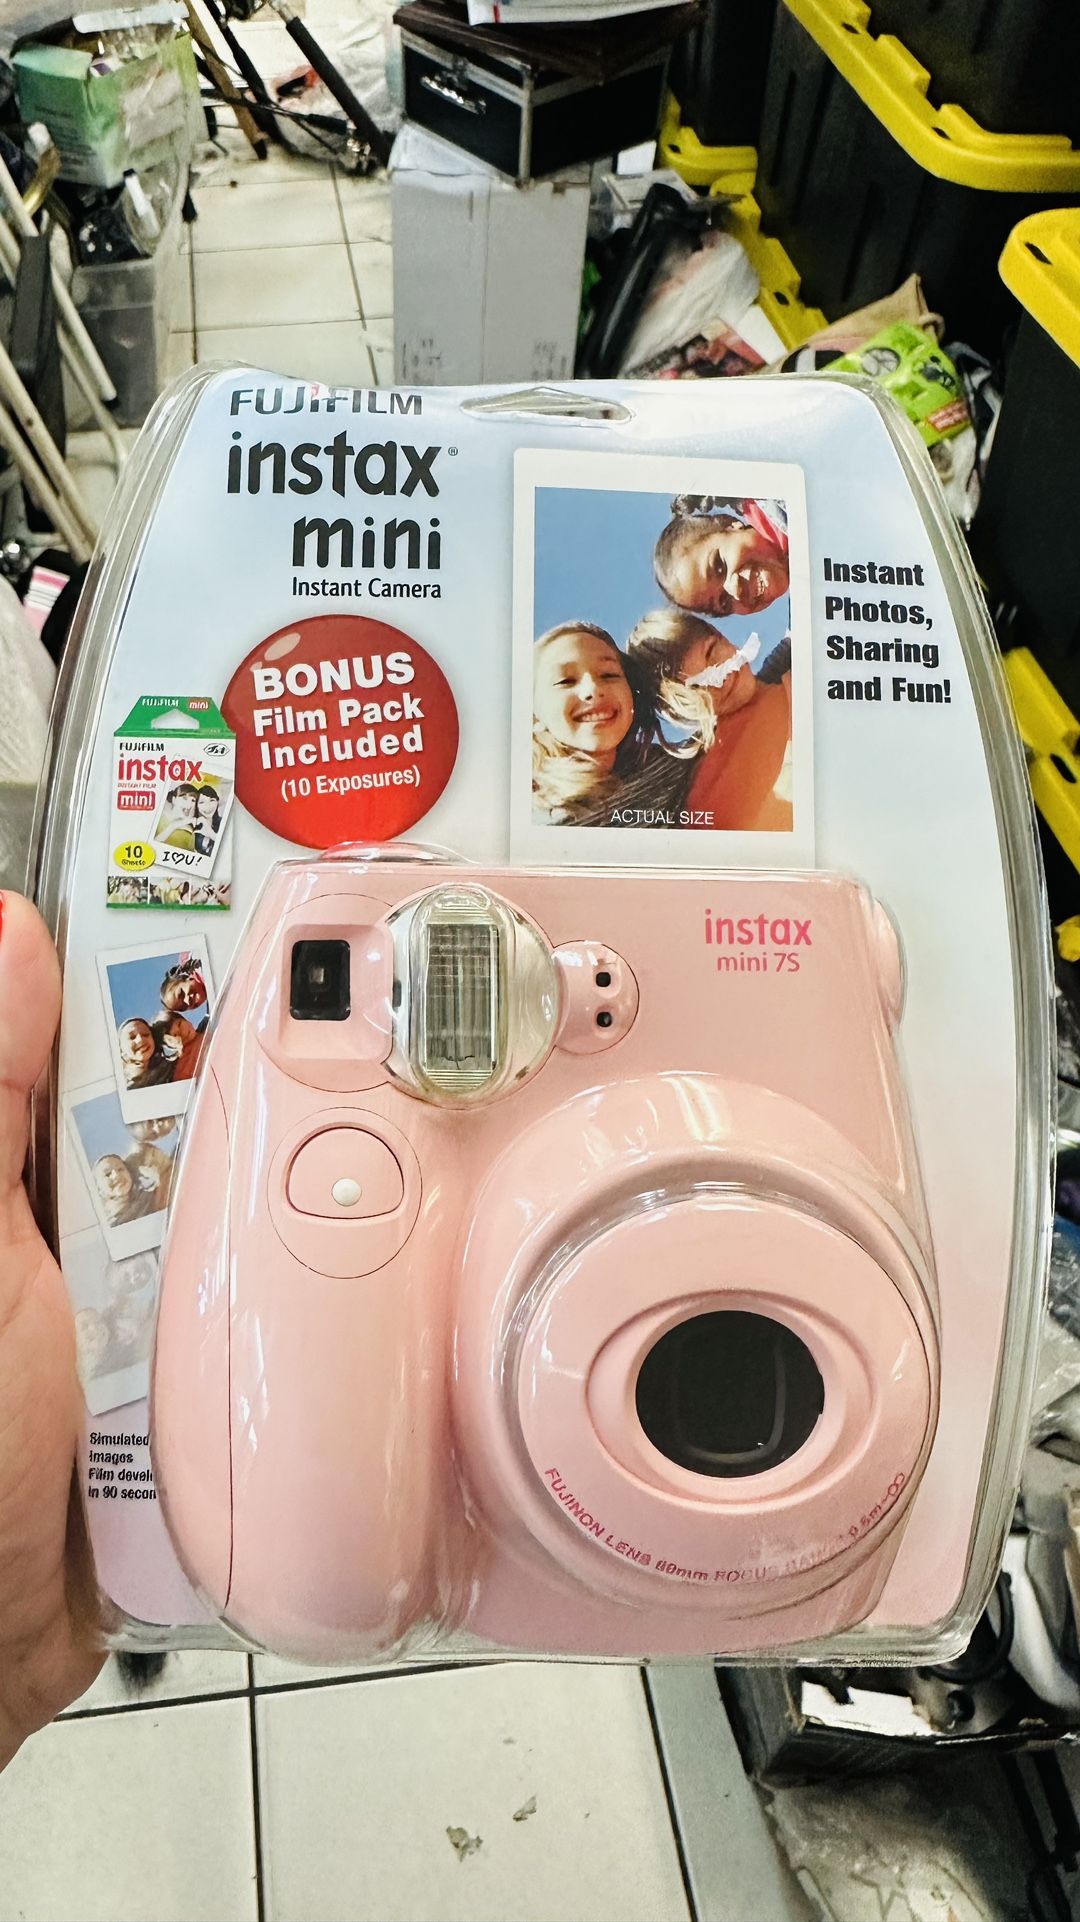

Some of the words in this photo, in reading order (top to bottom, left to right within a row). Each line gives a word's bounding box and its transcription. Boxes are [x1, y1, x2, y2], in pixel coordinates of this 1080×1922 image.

[230, 385, 422, 415] FUJIFILM
[292, 516, 441, 569] mini
[824, 558, 924, 586] Instant
[292, 577, 362, 597] Instant
[368, 578, 441, 598] Camera
[825, 596, 933, 630] Photos,
[826, 635, 939, 668] Sharing
[253, 652, 415, 701] BONUS
[827, 677, 881, 701] and
[892, 677, 952, 703] Fun!
[189, 701, 209, 709] mini
[253, 706, 327, 737] Film
[339, 692, 424, 727] Pack
[120, 742, 164, 751] FUJIFILM
[260, 724, 423, 770] Included
[117, 753, 203, 782] instax
[281, 778, 310, 802] (10
[317, 765, 421, 795] Exposures)
[121, 791, 152, 806] mini
[611, 809, 675, 824] ACTUAL
[679, 810, 714, 825] SIZE
[125, 845, 143, 858] 10
[705, 908, 812, 945] instax
[717, 952, 767, 971] mini
[774, 952, 800, 972] 7S
[90, 1432, 149, 1446] Simulated
[89, 1450, 134, 1465] Images
[88, 1467, 114, 1480] Film
[102, 1486, 117, 1498] 90
[545, 1467, 605, 1537] FUJINON
[605, 1534, 651, 1566] LENS
